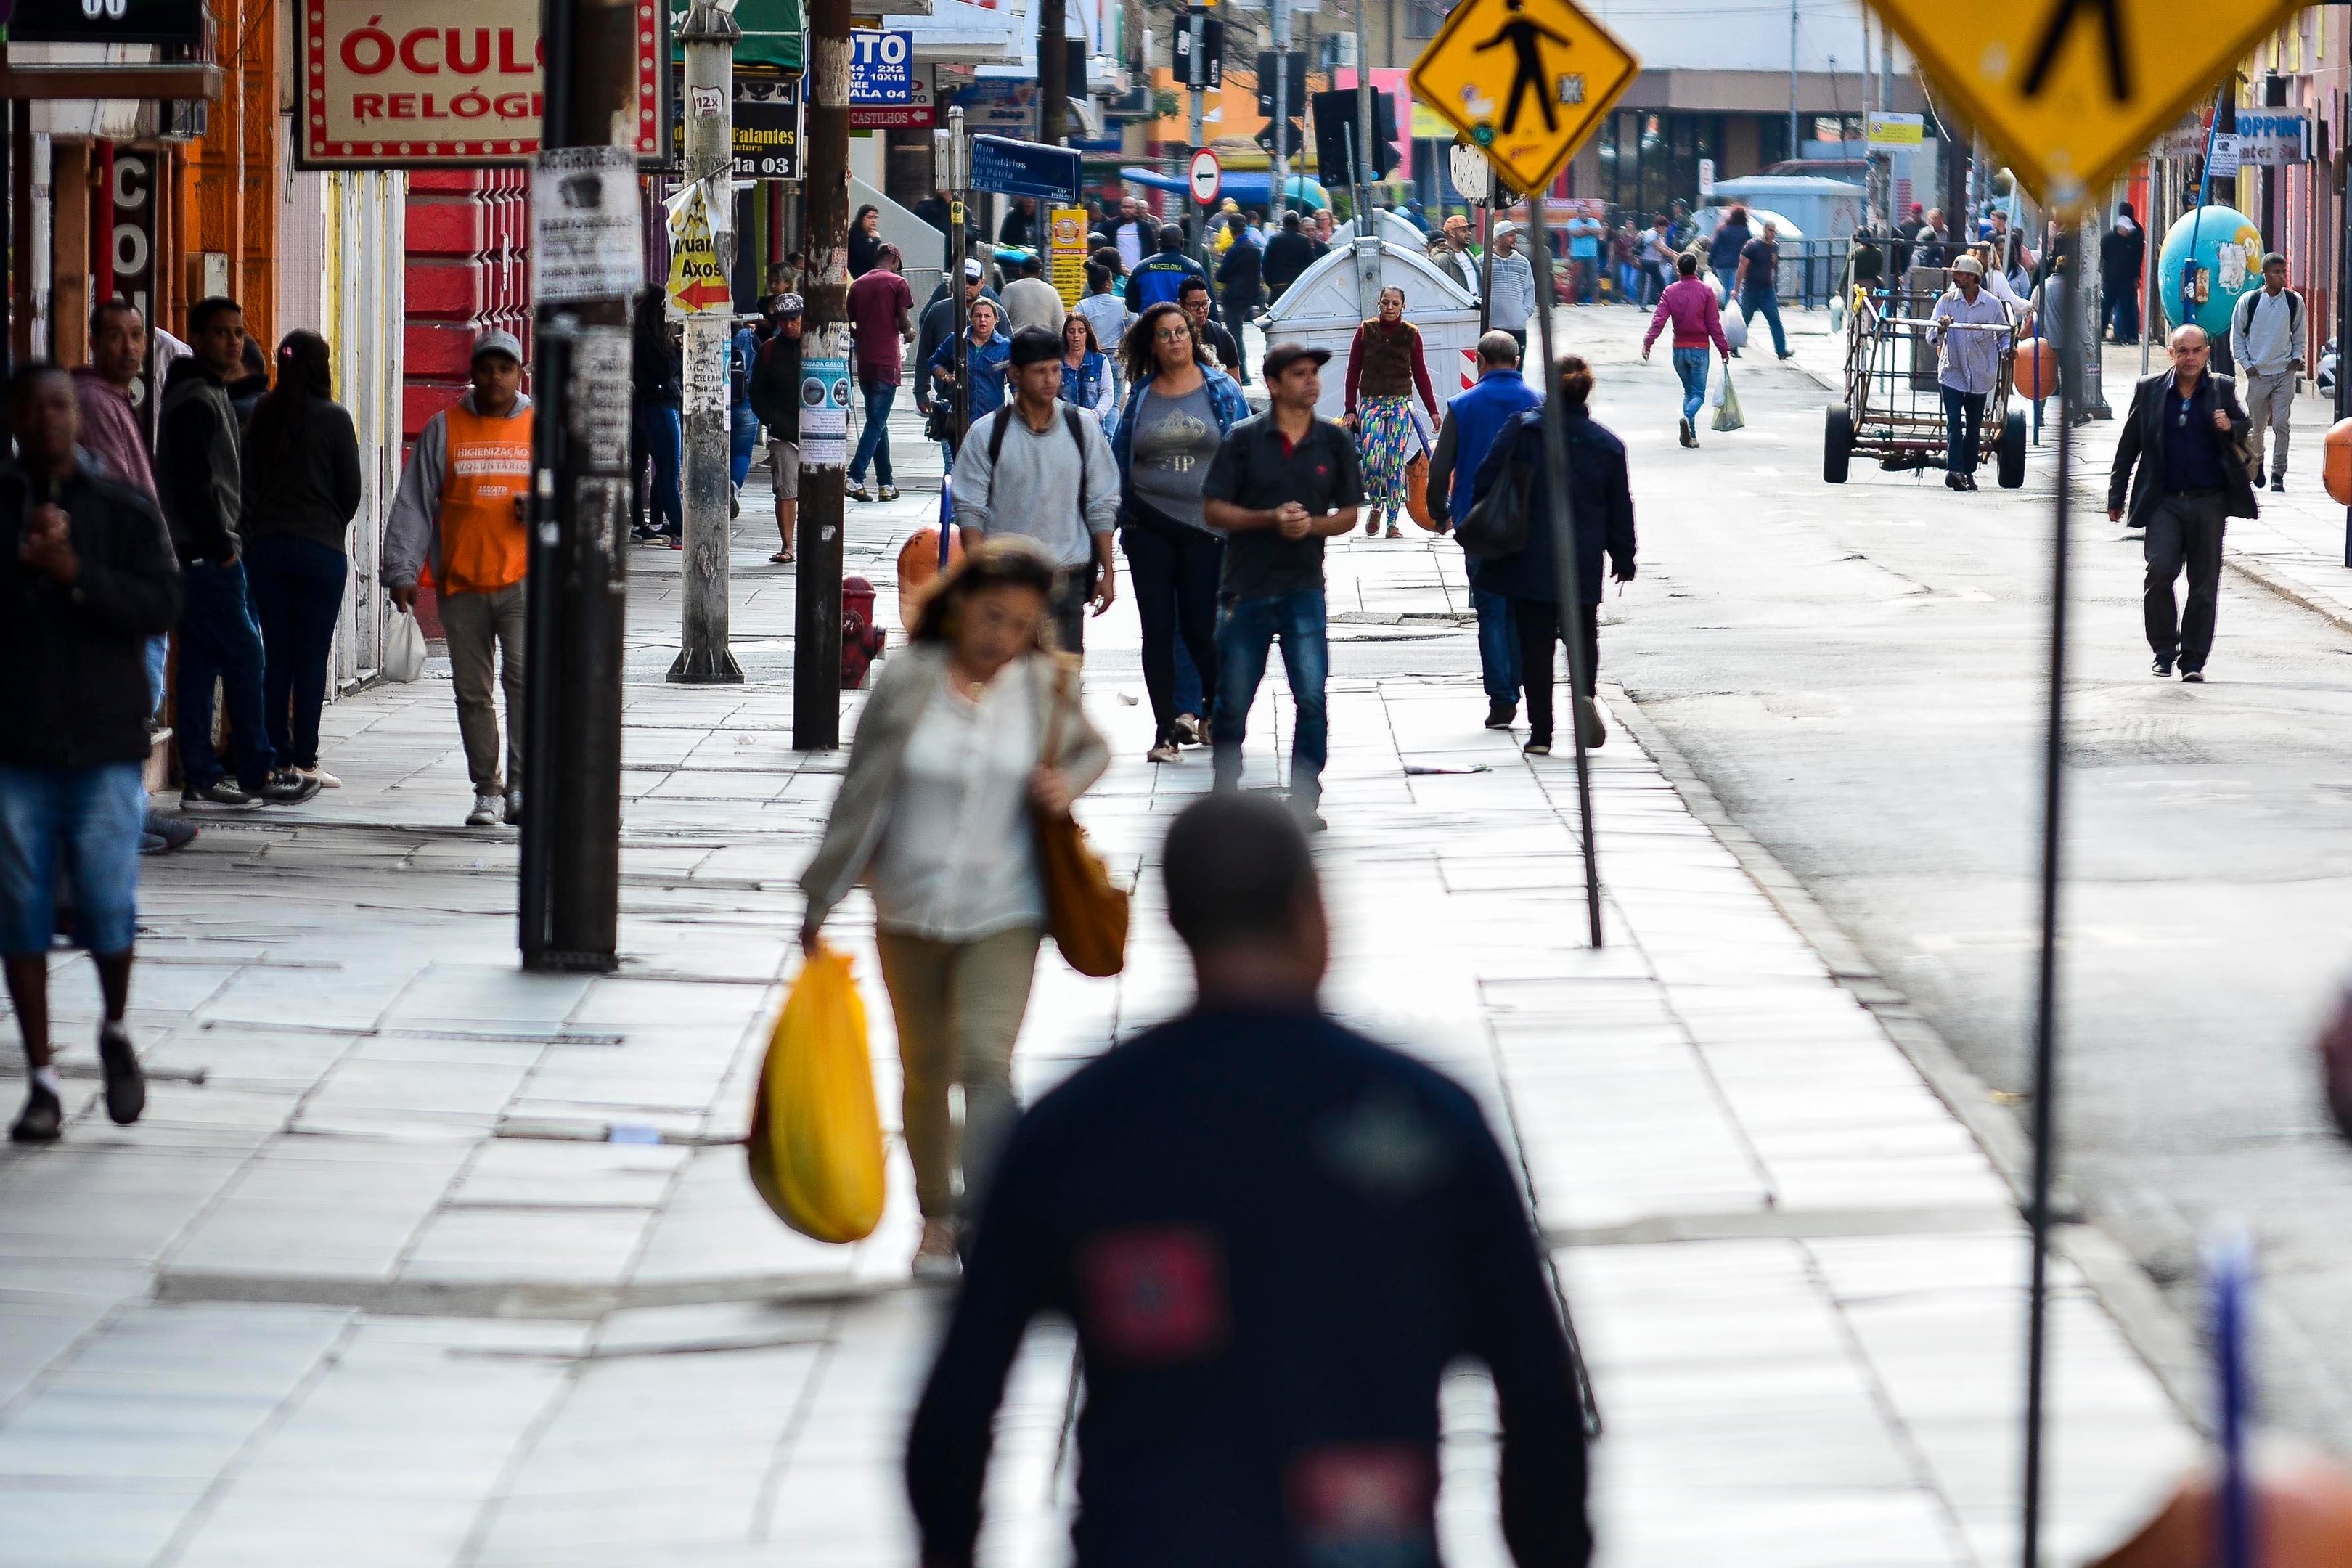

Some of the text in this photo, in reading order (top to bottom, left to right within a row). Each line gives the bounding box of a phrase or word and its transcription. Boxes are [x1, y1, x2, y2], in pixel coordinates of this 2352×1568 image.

[340, 14, 544, 74] ÓCUL
[850, 35, 906, 64] TO
[886, 90, 906, 99] 04
[851, 112, 908, 123] CASTILHOS
[976, 143, 994, 153] Rua
[762, 158, 789, 173] 03
[973, 155, 1026, 169] Voluntários
[986, 167, 1013, 179] Pátria
[457, 446, 528, 458] HIGIENIZAÇÃO
